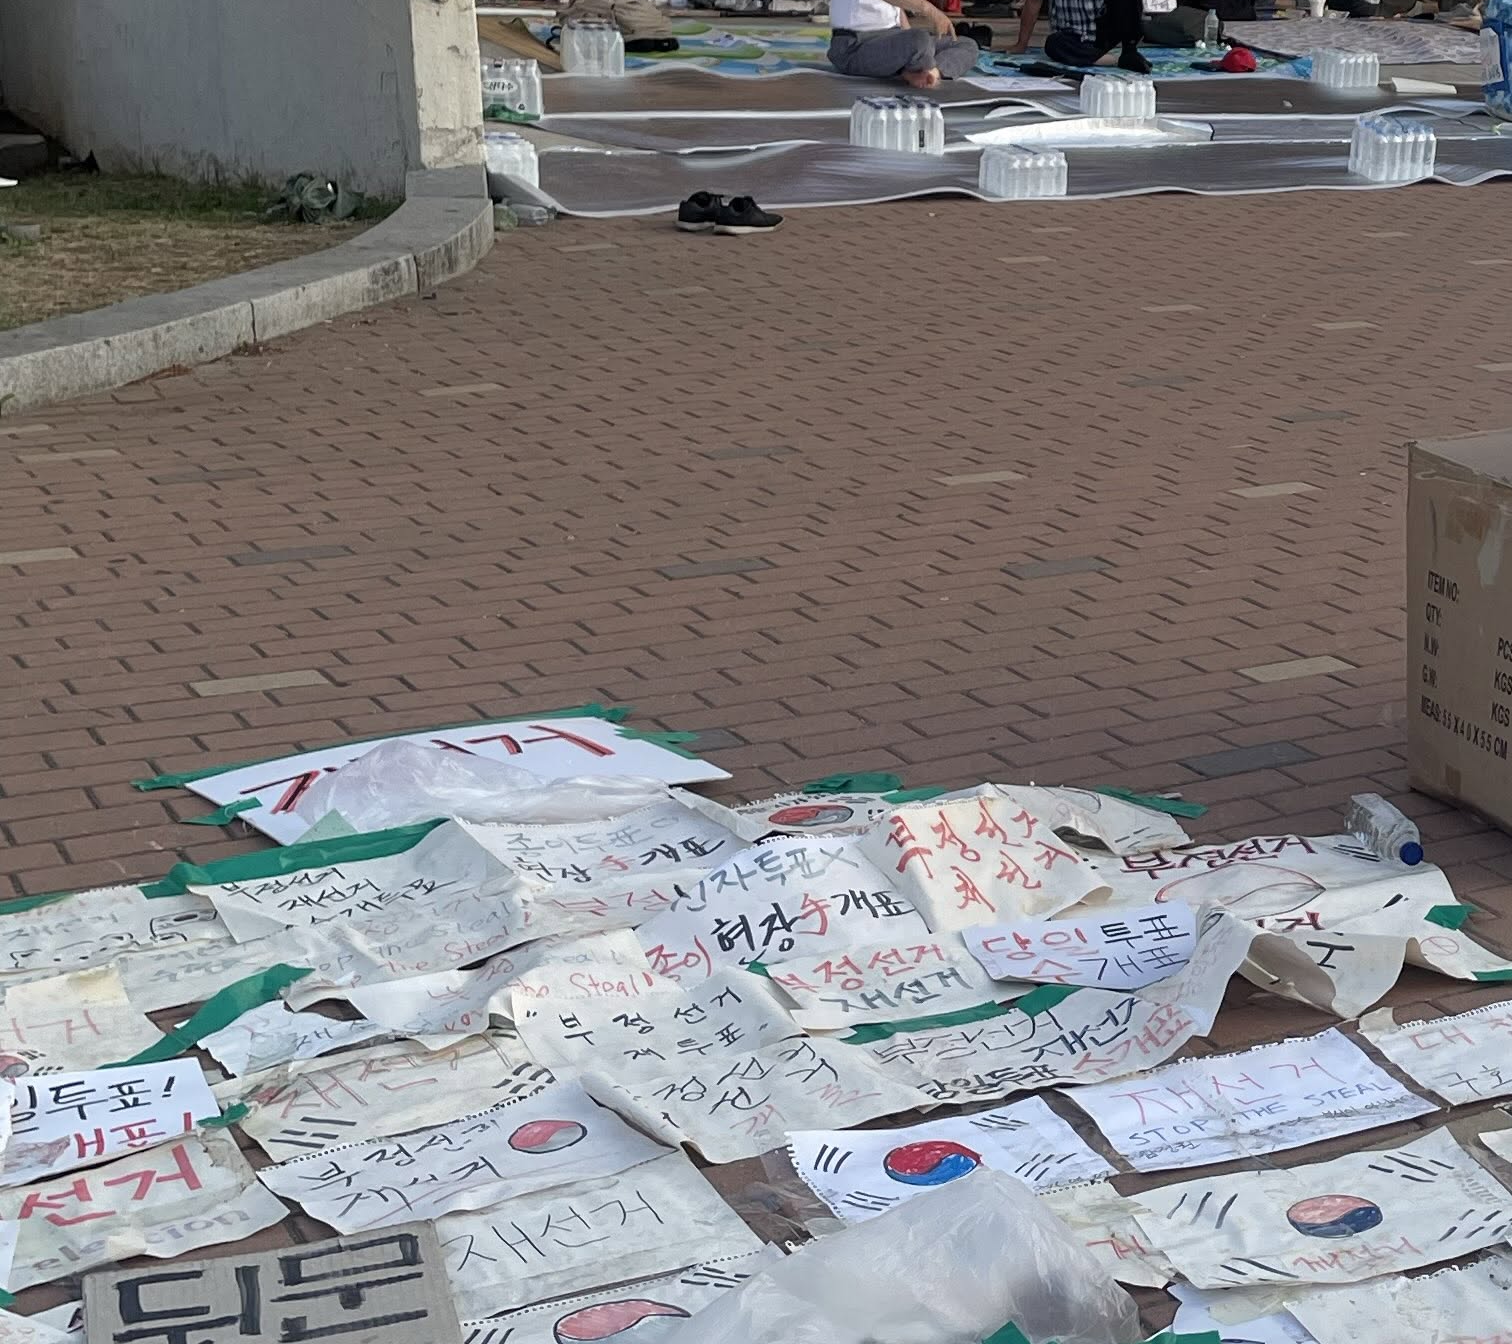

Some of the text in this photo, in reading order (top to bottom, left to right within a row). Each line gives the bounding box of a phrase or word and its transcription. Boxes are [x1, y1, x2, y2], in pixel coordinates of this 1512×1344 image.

[1427, 569, 1460, 605] ITEM NO:
[1425, 603, 1443, 627] QTY:
[1494, 670, 1512, 695] KGS
[1490, 702, 1511, 727] KGS
[1493, 738, 1508, 760] CM
[820, 967, 974, 1014] 재선거
[1109, 1057, 1341, 1126] 재선거
[1128, 1118, 1210, 1147] STOP
[1238, 1099, 1290, 1122] THE
[1303, 1078, 1393, 1109] STEAL
[297, 1117, 502, 1189] 부정선거
[442, 1191, 665, 1271] 재선거
